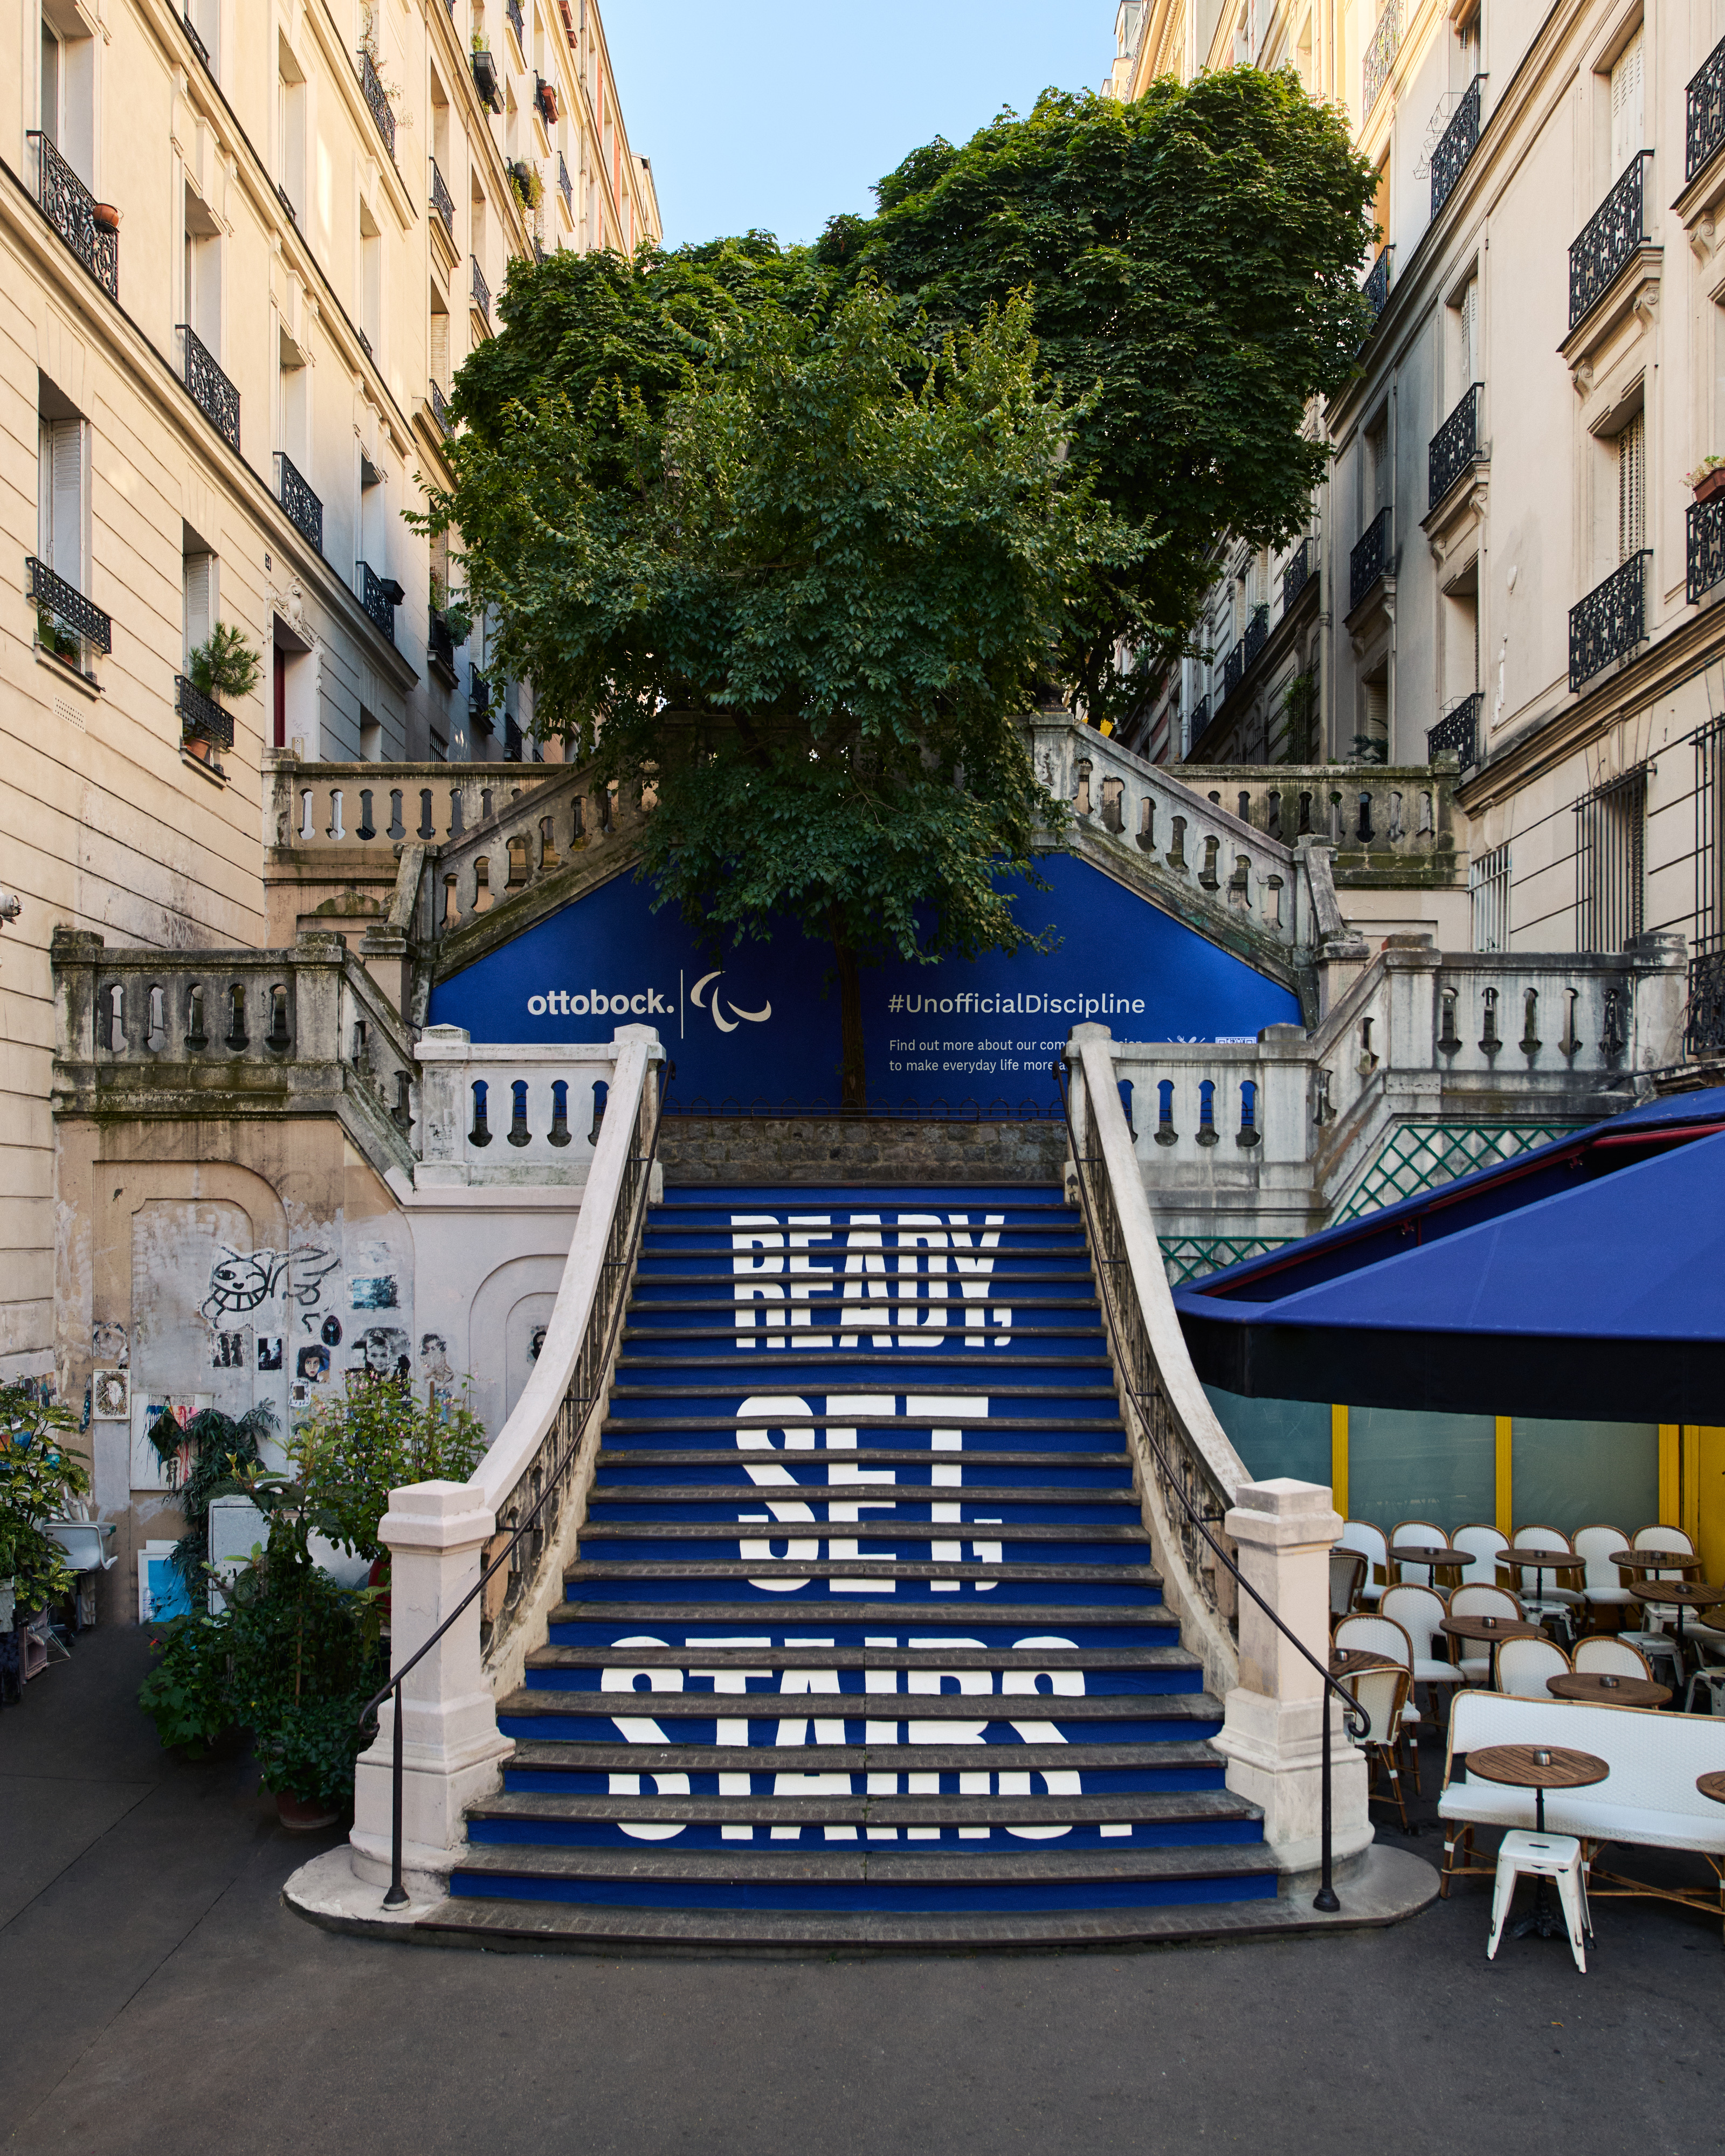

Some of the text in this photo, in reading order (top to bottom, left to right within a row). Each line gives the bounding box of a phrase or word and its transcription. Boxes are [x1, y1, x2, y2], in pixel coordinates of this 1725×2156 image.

[527, 988, 674, 1015] ottobock.
[888, 993, 1145, 1018] #UnofficialDiscipline
[889, 1039, 915, 1051] Find
[919, 1040, 940, 1051] out
[943, 1041, 974, 1051] more
[978, 1039, 1013, 1051] about
[1017, 1041, 1037, 1051] our
[889, 1060, 902, 1071] to
[907, 1059, 939, 1071] make
[943, 1059, 997, 1074] everyday
[1000, 1059, 1019, 1070] life
[1024, 1061, 1053, 1070] more
[730, 1214, 1012, 1348] READY,
[736, 1395, 1002, 1592] SET,
[601, 1636, 1132, 1840] STAIRS.
